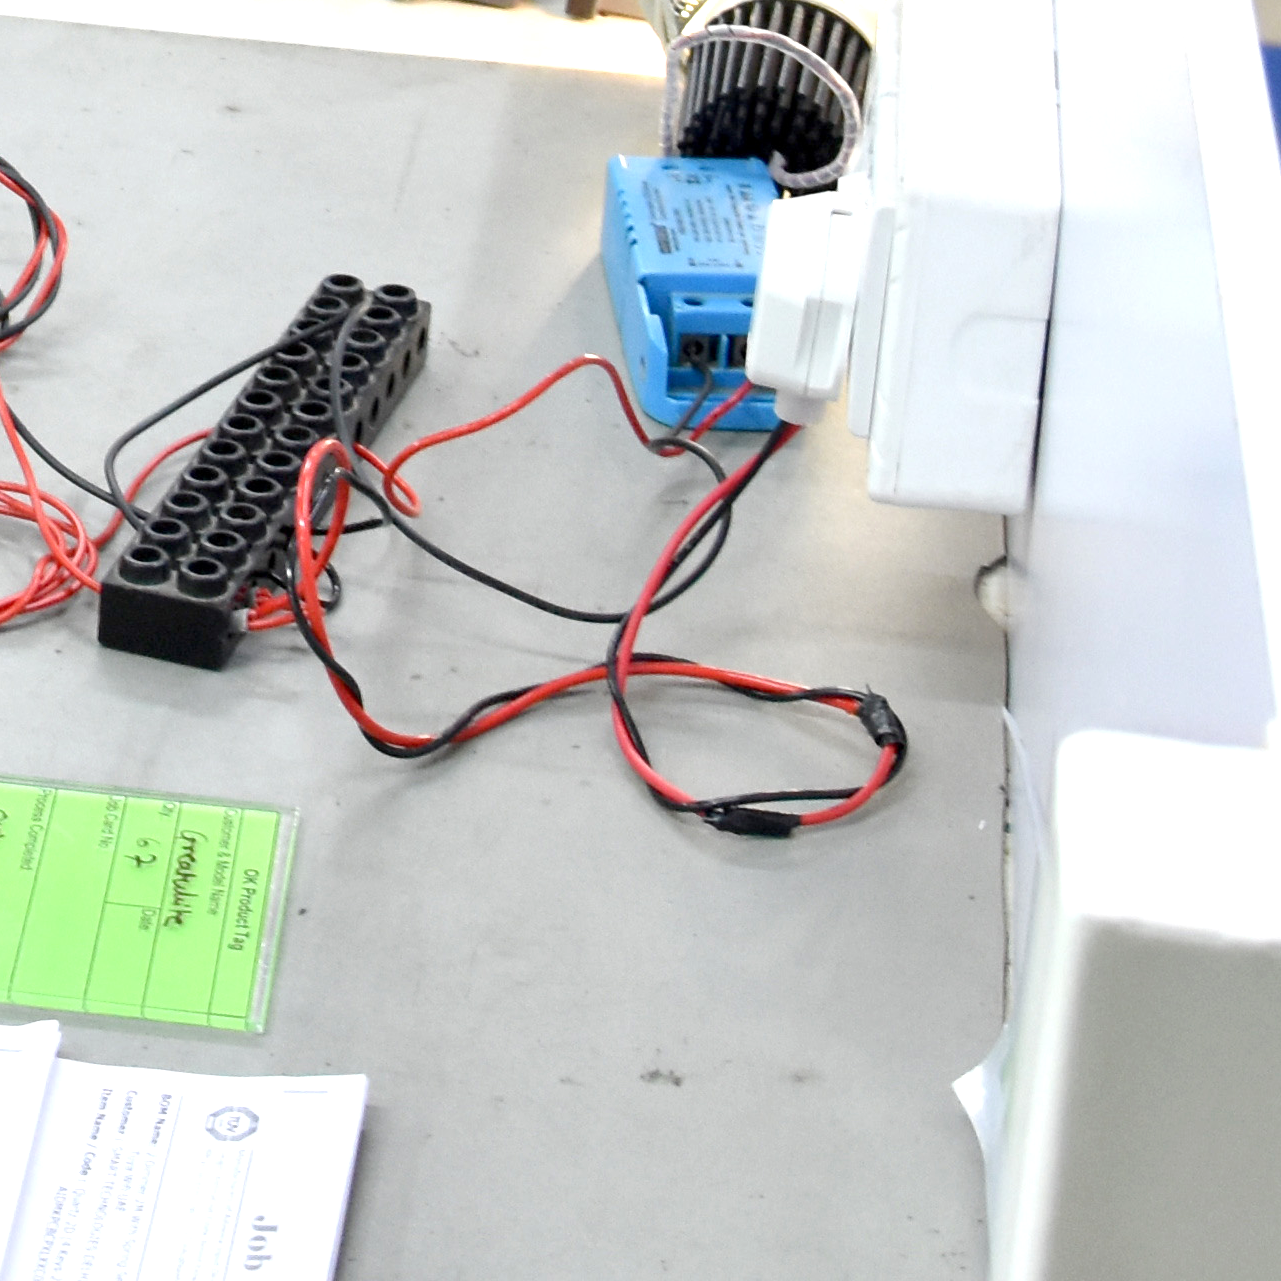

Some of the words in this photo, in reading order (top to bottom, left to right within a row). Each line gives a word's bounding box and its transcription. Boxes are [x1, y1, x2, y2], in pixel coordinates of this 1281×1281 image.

[33, 790, 51, 821] Process
[106, 795, 118, 811] Job
[102, 815, 117, 834] Card
[220, 810, 237, 849] Customer
[21, 825, 43, 870] Completed
[213, 861, 229, 886] Model
[243, 869, 259, 884] OK
[210, 889, 224, 915] Name
[235, 888, 256, 928] Product
[227, 932, 250, 950] Tag
[99, 1089, 113, 1110] Item
[158, 1094, 172, 1114] BOM
[118, 1091, 137, 1134] Customer
[90, 1114, 106, 1140] Name
[79, 1152, 96, 1175] Code
[244, 1215, 278, 1271] Job
